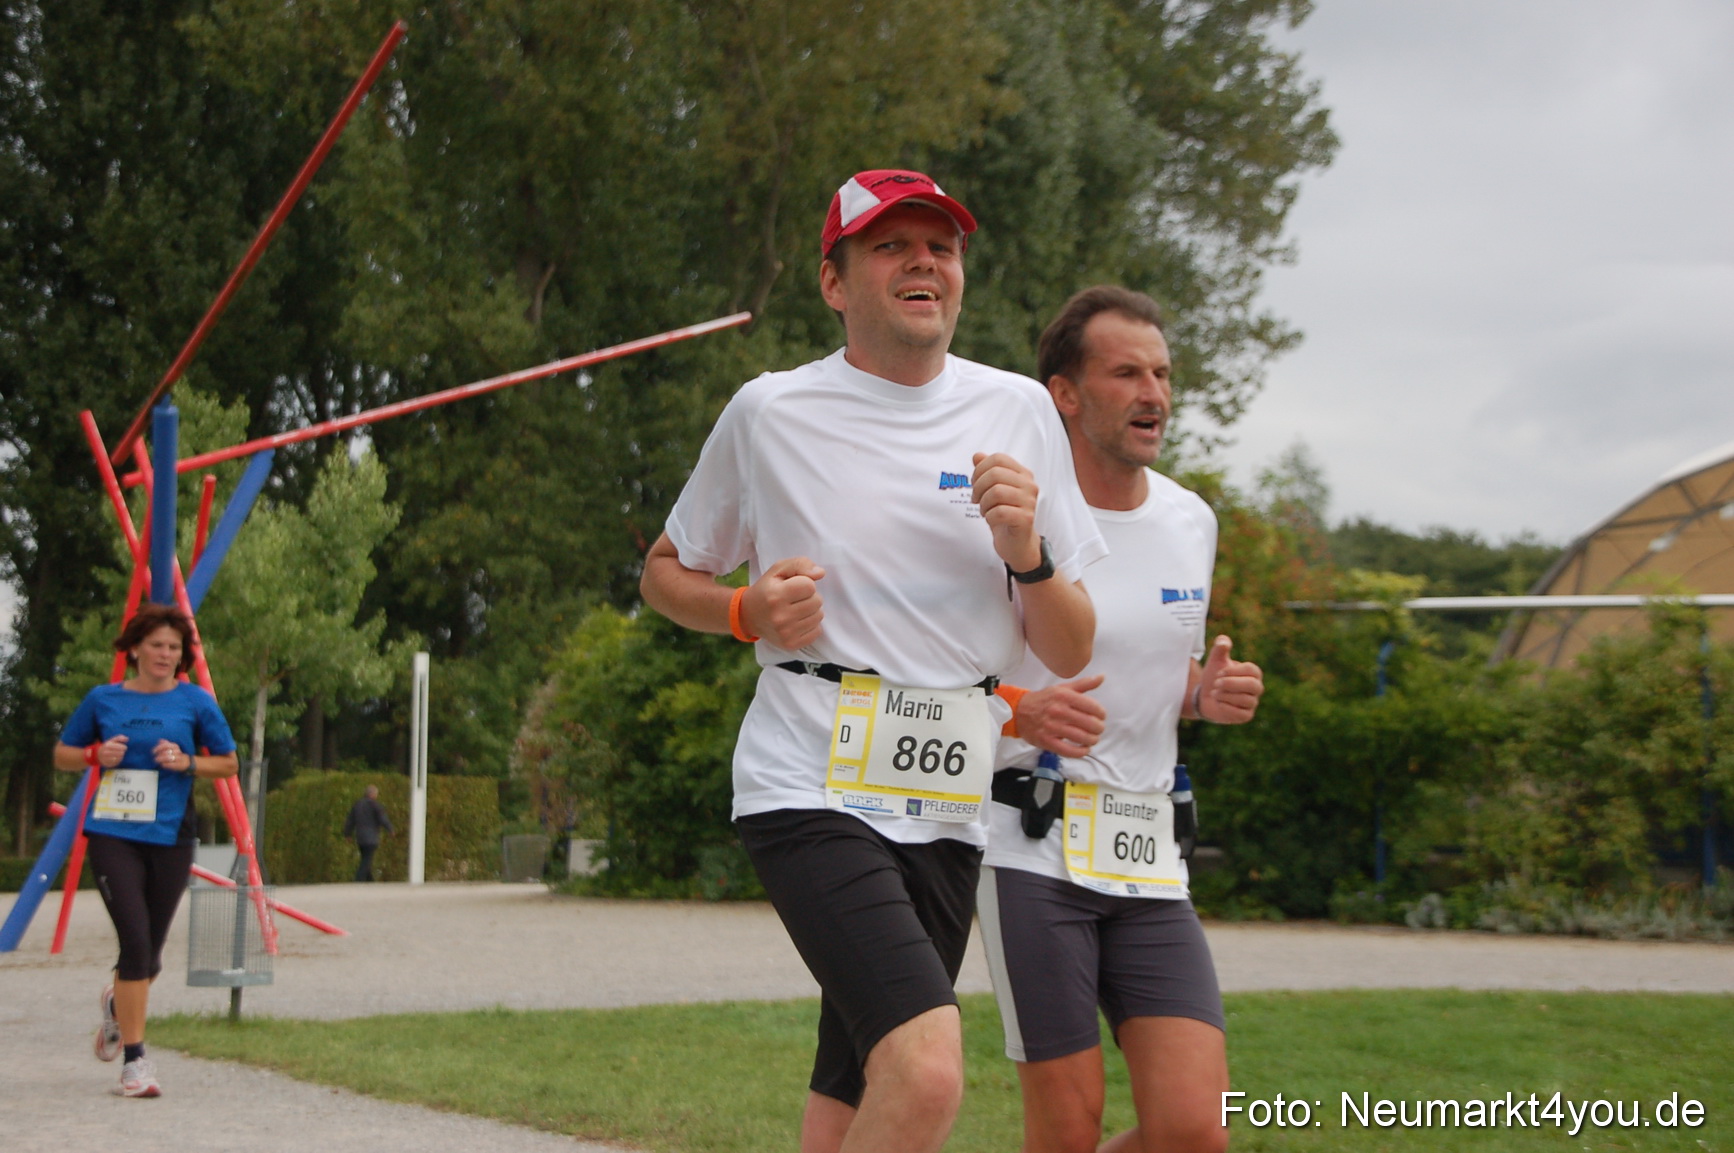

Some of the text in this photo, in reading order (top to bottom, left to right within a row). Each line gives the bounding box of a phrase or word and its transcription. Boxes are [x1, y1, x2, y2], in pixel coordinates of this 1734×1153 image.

[939, 471, 973, 490] AUL
[885, 689, 943, 721] Mario
[840, 725, 851, 743] D
[892, 735, 968, 776] 866
[117, 789, 145, 804] 560
[924, 799, 979, 814] PFLEIDERER
[1103, 793, 1158, 821] Guenter
[1070, 823, 1078, 838] C
[1114, 831, 1156, 865] 600
